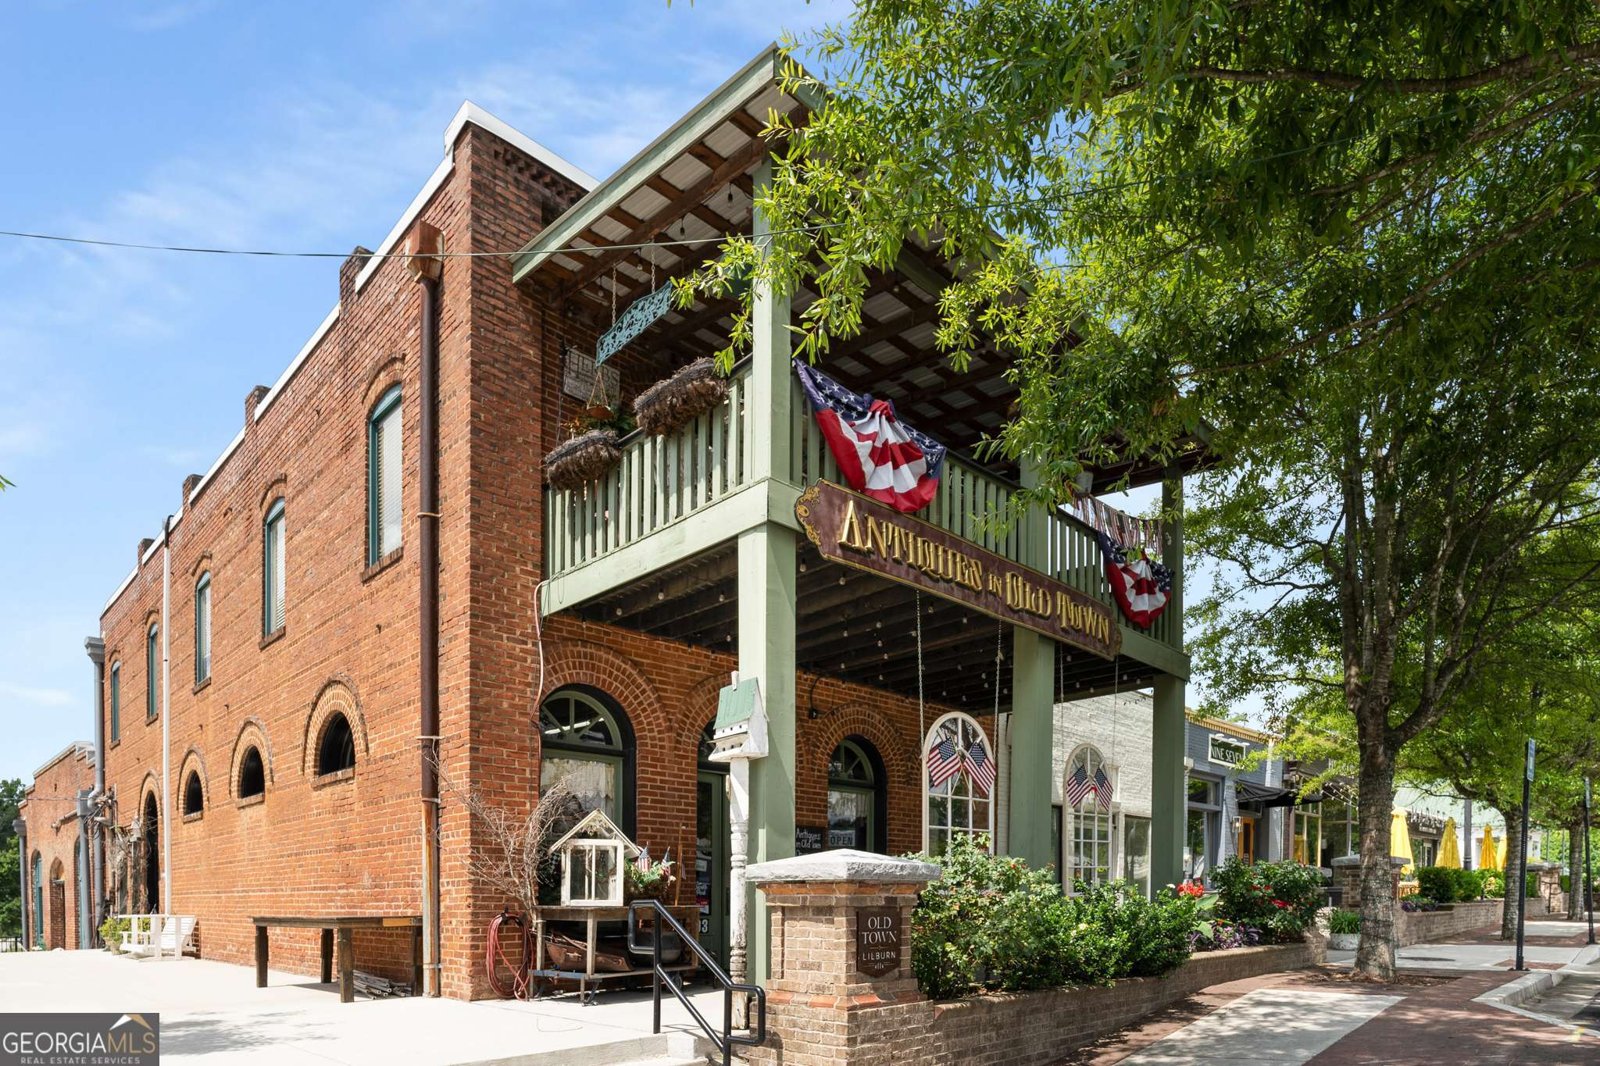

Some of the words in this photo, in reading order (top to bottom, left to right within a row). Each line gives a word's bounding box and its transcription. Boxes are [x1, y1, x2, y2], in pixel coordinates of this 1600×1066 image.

[838, 499, 982, 592] ANTIQUES
[988, 573, 1002, 598] IN
[1005, 571, 1052, 618] OLD
[1056, 591, 1109, 645] TOWN
[1211, 745, 1225, 761] NINE
[830, 835, 853, 846] OPEN
[868, 916, 892, 930] OLD
[861, 931, 897, 944] TOWN
[862, 951, 896, 961] LILBURN
